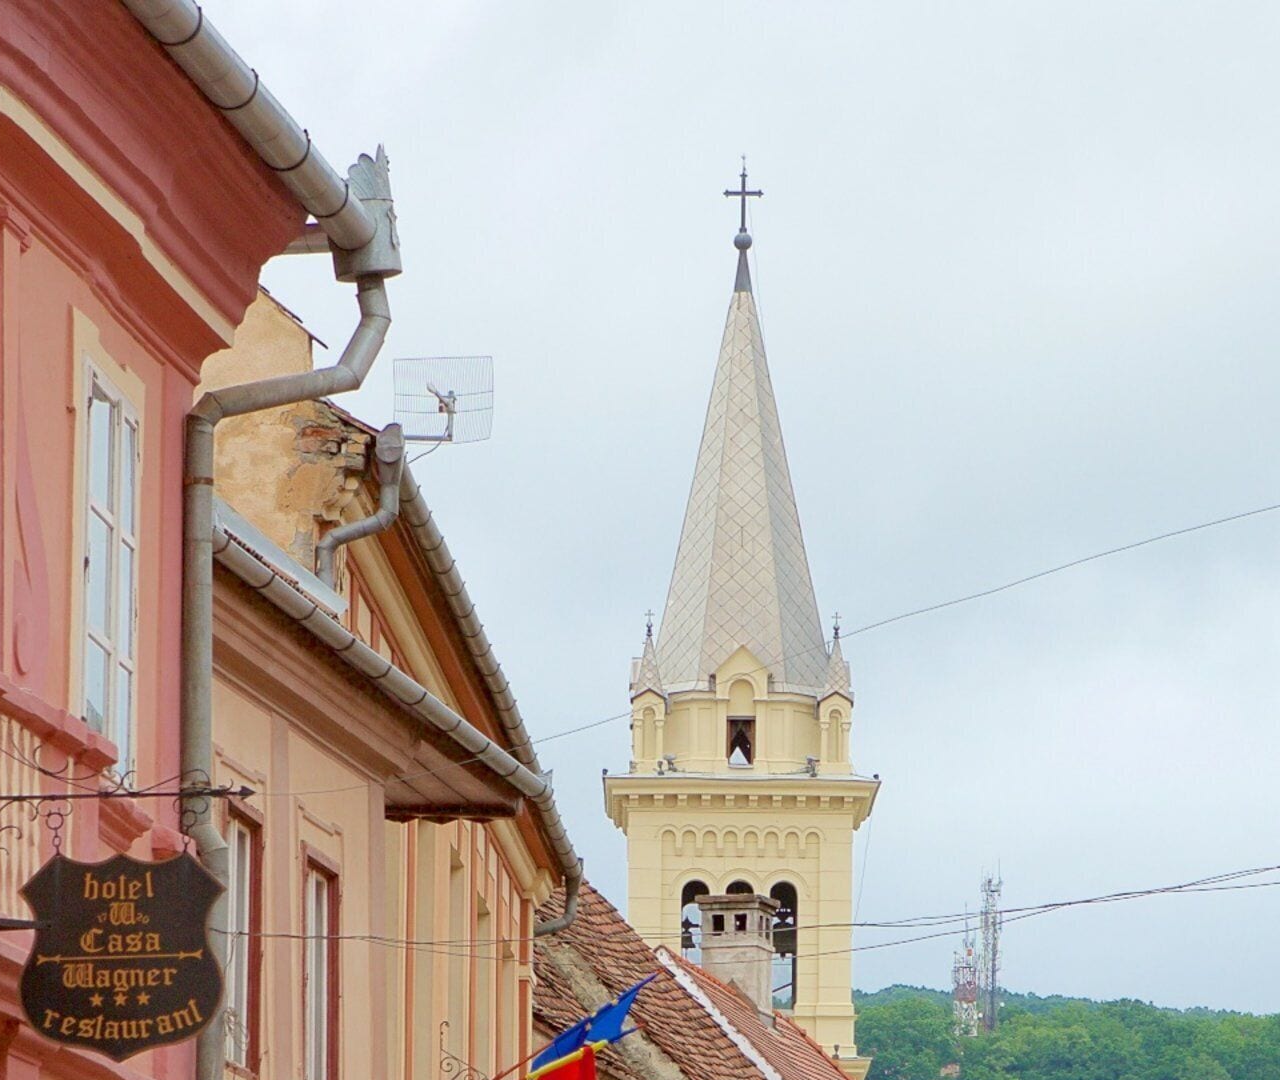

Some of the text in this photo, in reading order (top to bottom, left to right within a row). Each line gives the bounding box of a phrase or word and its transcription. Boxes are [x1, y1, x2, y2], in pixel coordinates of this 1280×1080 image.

[83, 871, 154, 899] hotel
[109, 902, 136, 926] W
[79, 927, 161, 954] Casa
[63, 963, 177, 992] Wagner
[44, 999, 202, 1040] restaurant
